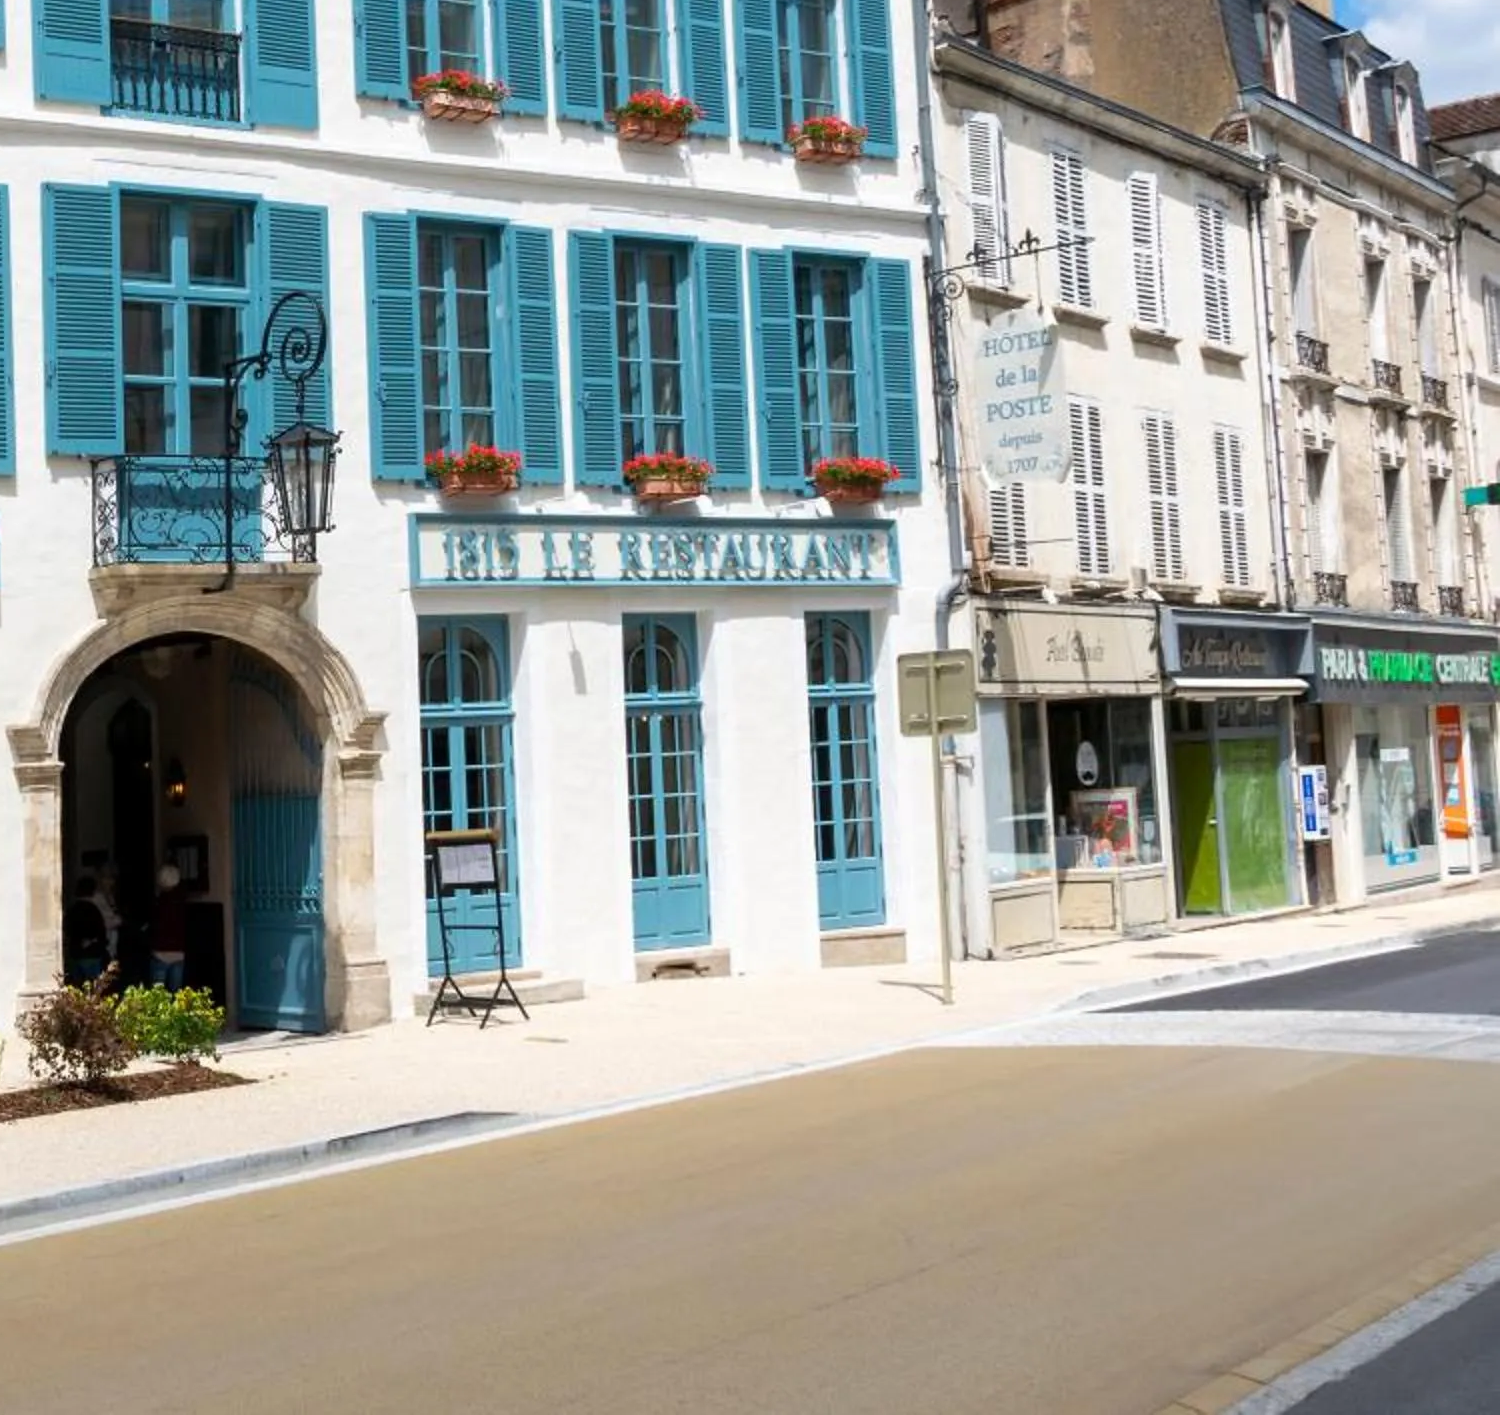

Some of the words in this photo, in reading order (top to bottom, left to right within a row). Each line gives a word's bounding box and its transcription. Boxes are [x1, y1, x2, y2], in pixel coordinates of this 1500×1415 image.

[995, 368, 1017, 388] de
[1022, 364, 1038, 383] la
[986, 394, 1054, 423] POSTE
[998, 428, 1044, 450] depuis
[1007, 456, 1039, 475] 1707
[441, 528, 520, 573] 1815
[541, 530, 595, 573] LE
[617, 530, 872, 573] RESTAURANT
[1321, 647, 1357, 680] PARA
[1358, 648, 1369, 681] &
[1435, 653, 1490, 684] CENTRALE
